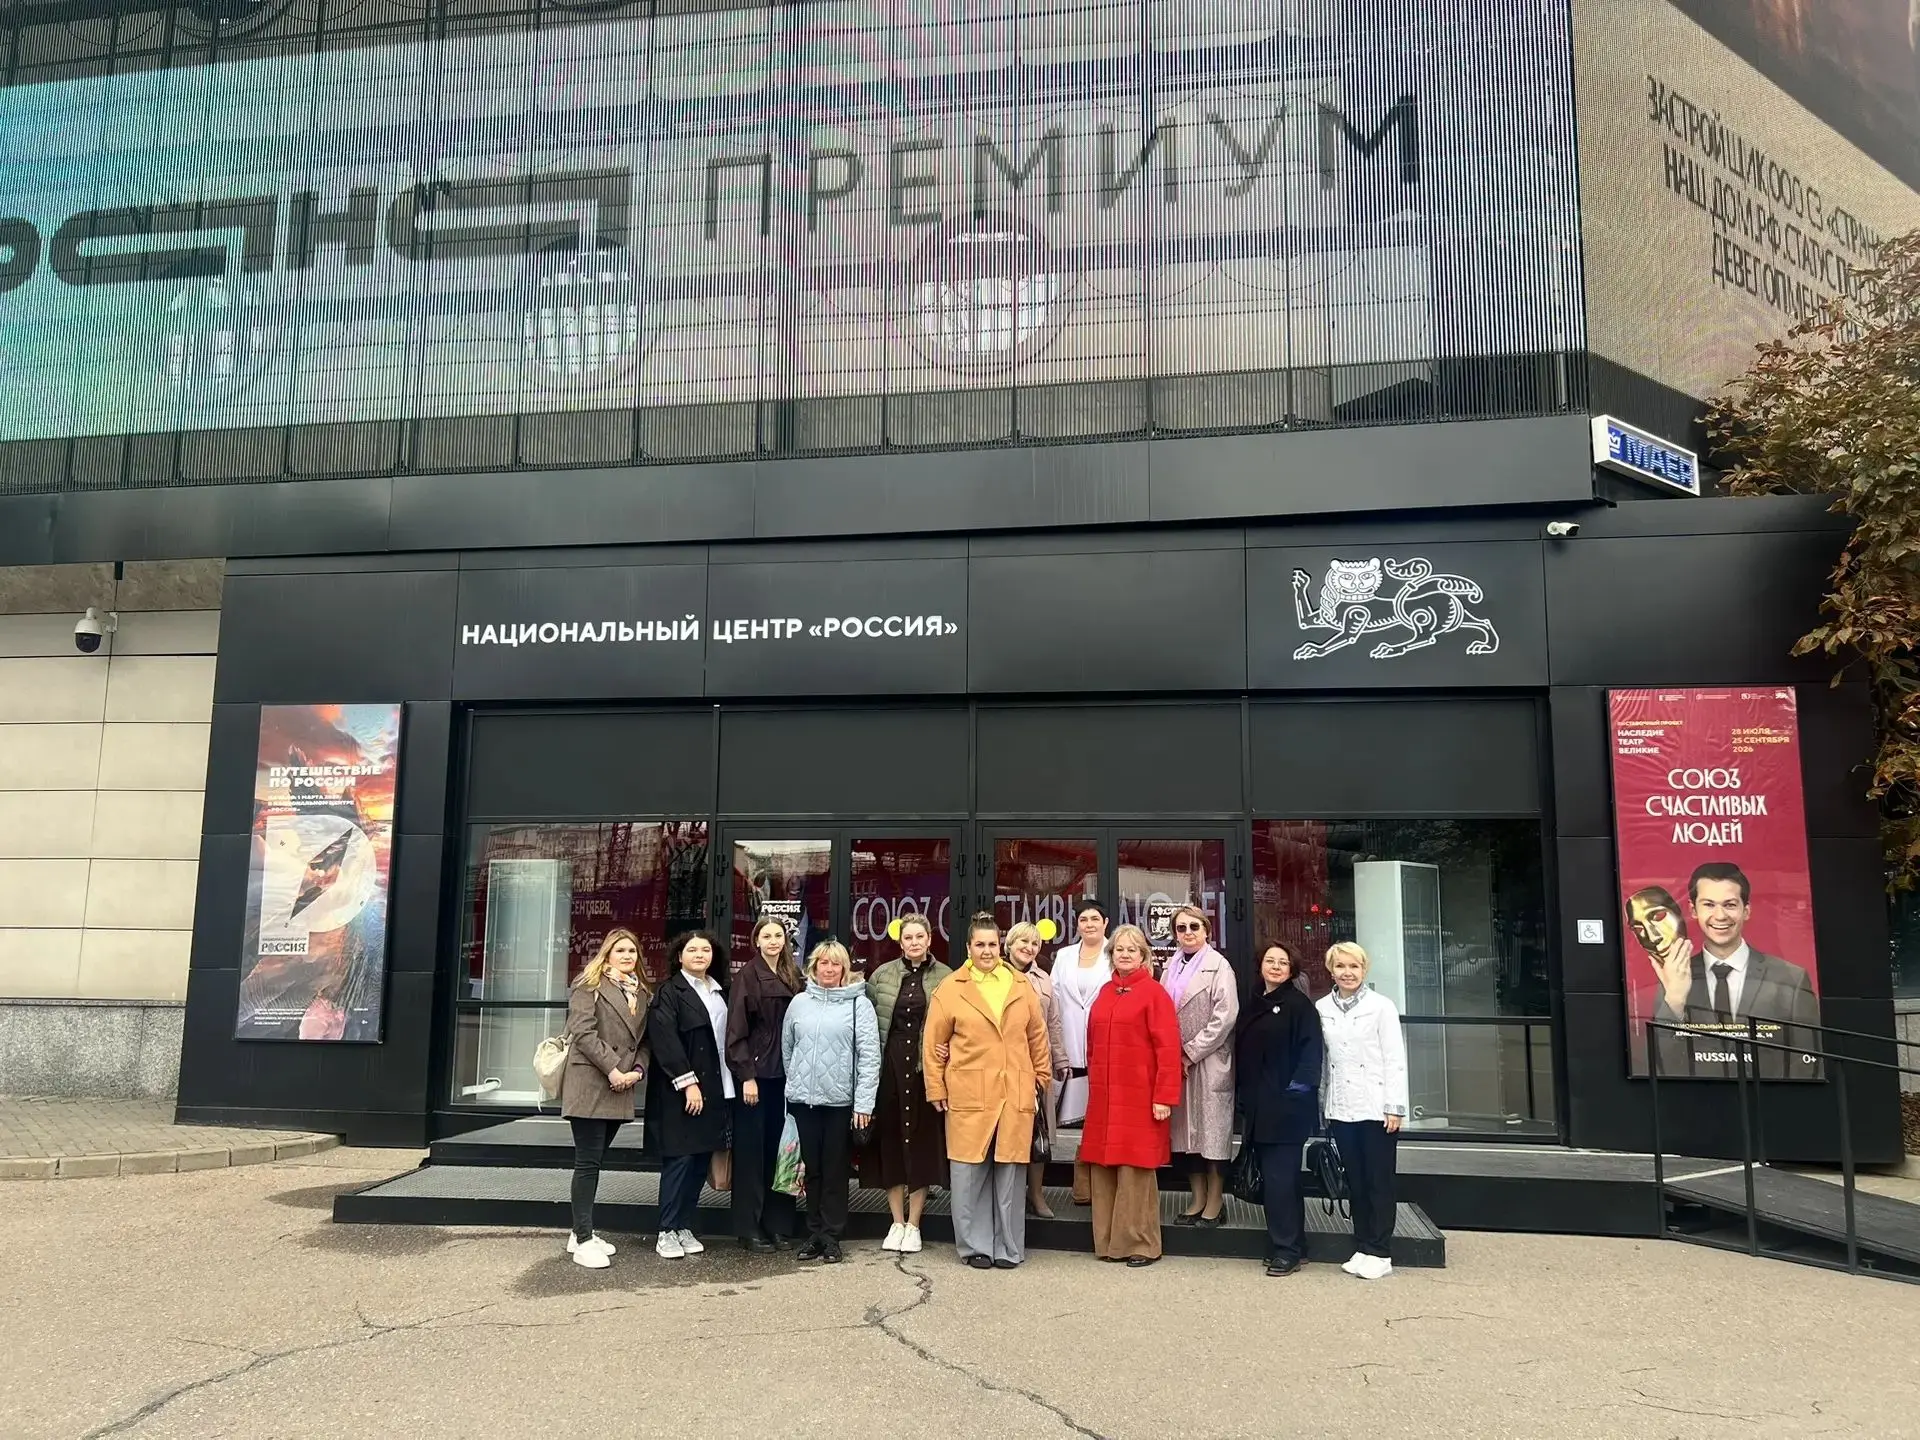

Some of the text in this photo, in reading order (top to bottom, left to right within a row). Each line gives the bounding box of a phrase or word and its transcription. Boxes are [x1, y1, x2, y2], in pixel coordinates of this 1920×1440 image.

[1646, 74, 1768, 197] ЗАСТРОЙЩИК
[704, 95, 1417, 239] ПРЕМИУМ
[462, 614, 959, 647] НАЦИОНАЛЬНЫЙ ЦЕНТР «РОССИЯ»
[1618, 729, 1664, 737] НАСЛЕДИЕ
[1743, 736, 1790, 744] СЕНТЯБРЯ
[270, 766, 383, 776] ПУТЕШЕСТВИЕ
[1668, 768, 1741, 789] СОЮЗ
[269, 776, 356, 788] ПО РОССИИ
[1645, 795, 1768, 817] СЧАСТЛИВЫХ
[1672, 819, 1743, 846] ЛЮДЕЙ
